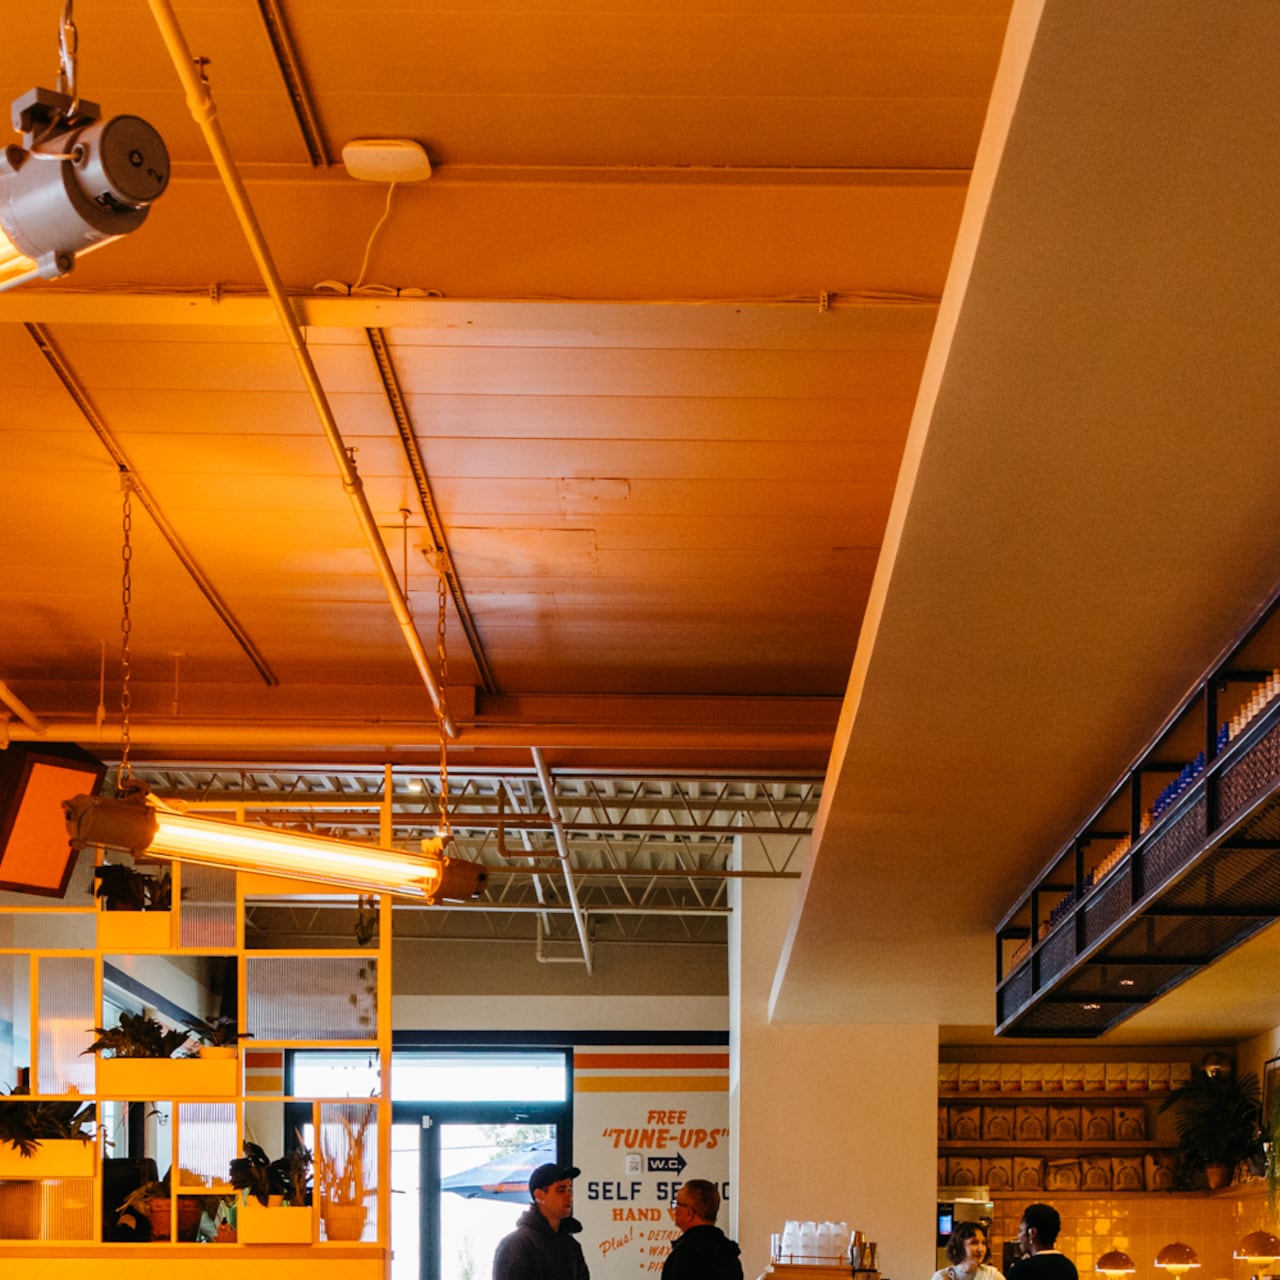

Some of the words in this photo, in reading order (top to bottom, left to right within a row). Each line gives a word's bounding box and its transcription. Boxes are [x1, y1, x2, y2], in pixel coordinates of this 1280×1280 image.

[647, 1110, 687, 1125] FREE
[650, 1160, 682, 1169] W.C.
[588, 1182, 642, 1200] SELF
[612, 1208, 662, 1221] HAND
[599, 1226, 633, 1257] Plus!
